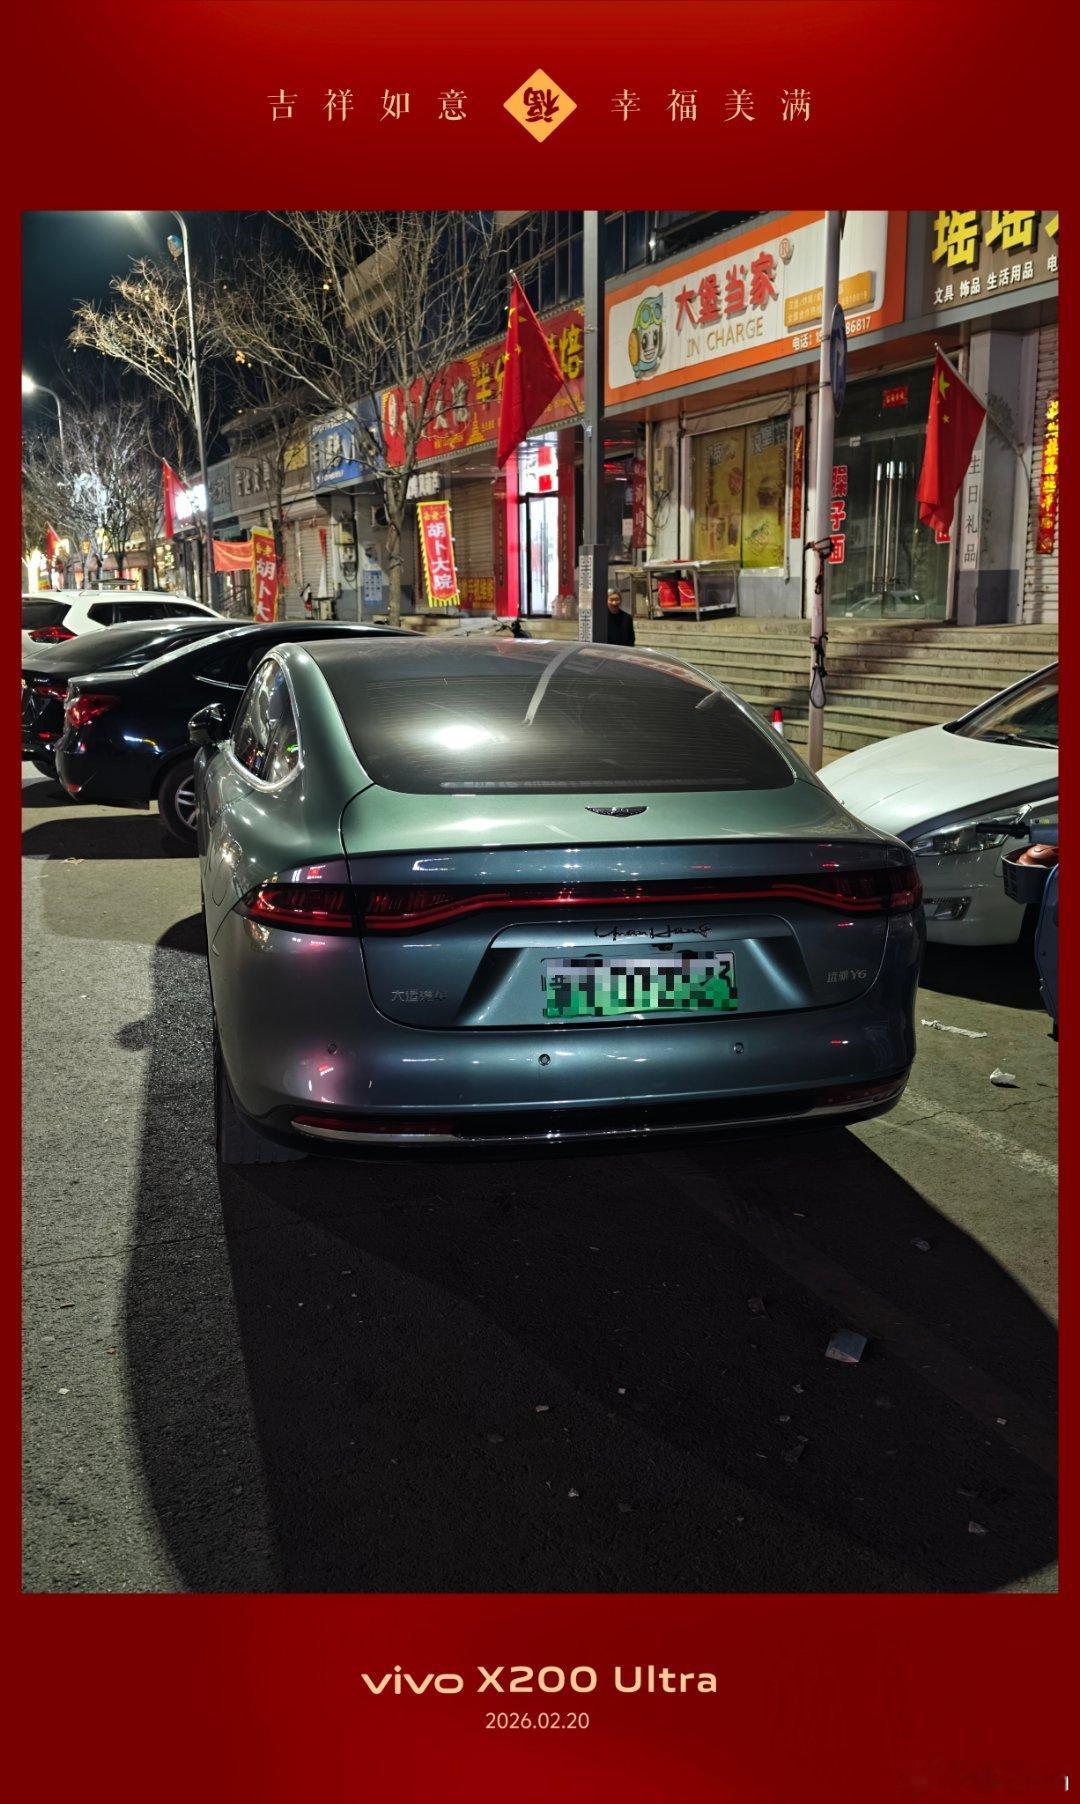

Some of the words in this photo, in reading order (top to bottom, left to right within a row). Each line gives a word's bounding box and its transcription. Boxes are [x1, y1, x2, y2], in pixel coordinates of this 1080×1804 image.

[674, 251, 779, 333] 大堡当家
[933, 284, 954, 305] 文具
[959, 276, 981, 299] 饰品
[986, 260, 1034, 291] 生活用品
[686, 338, 700, 359] IN
[706, 316, 764, 352] CHARGE
[963, 454, 981, 563] 生日礼品
[426, 522, 454, 591] 胡卜大院
[850, 968, 867, 980] Y6
